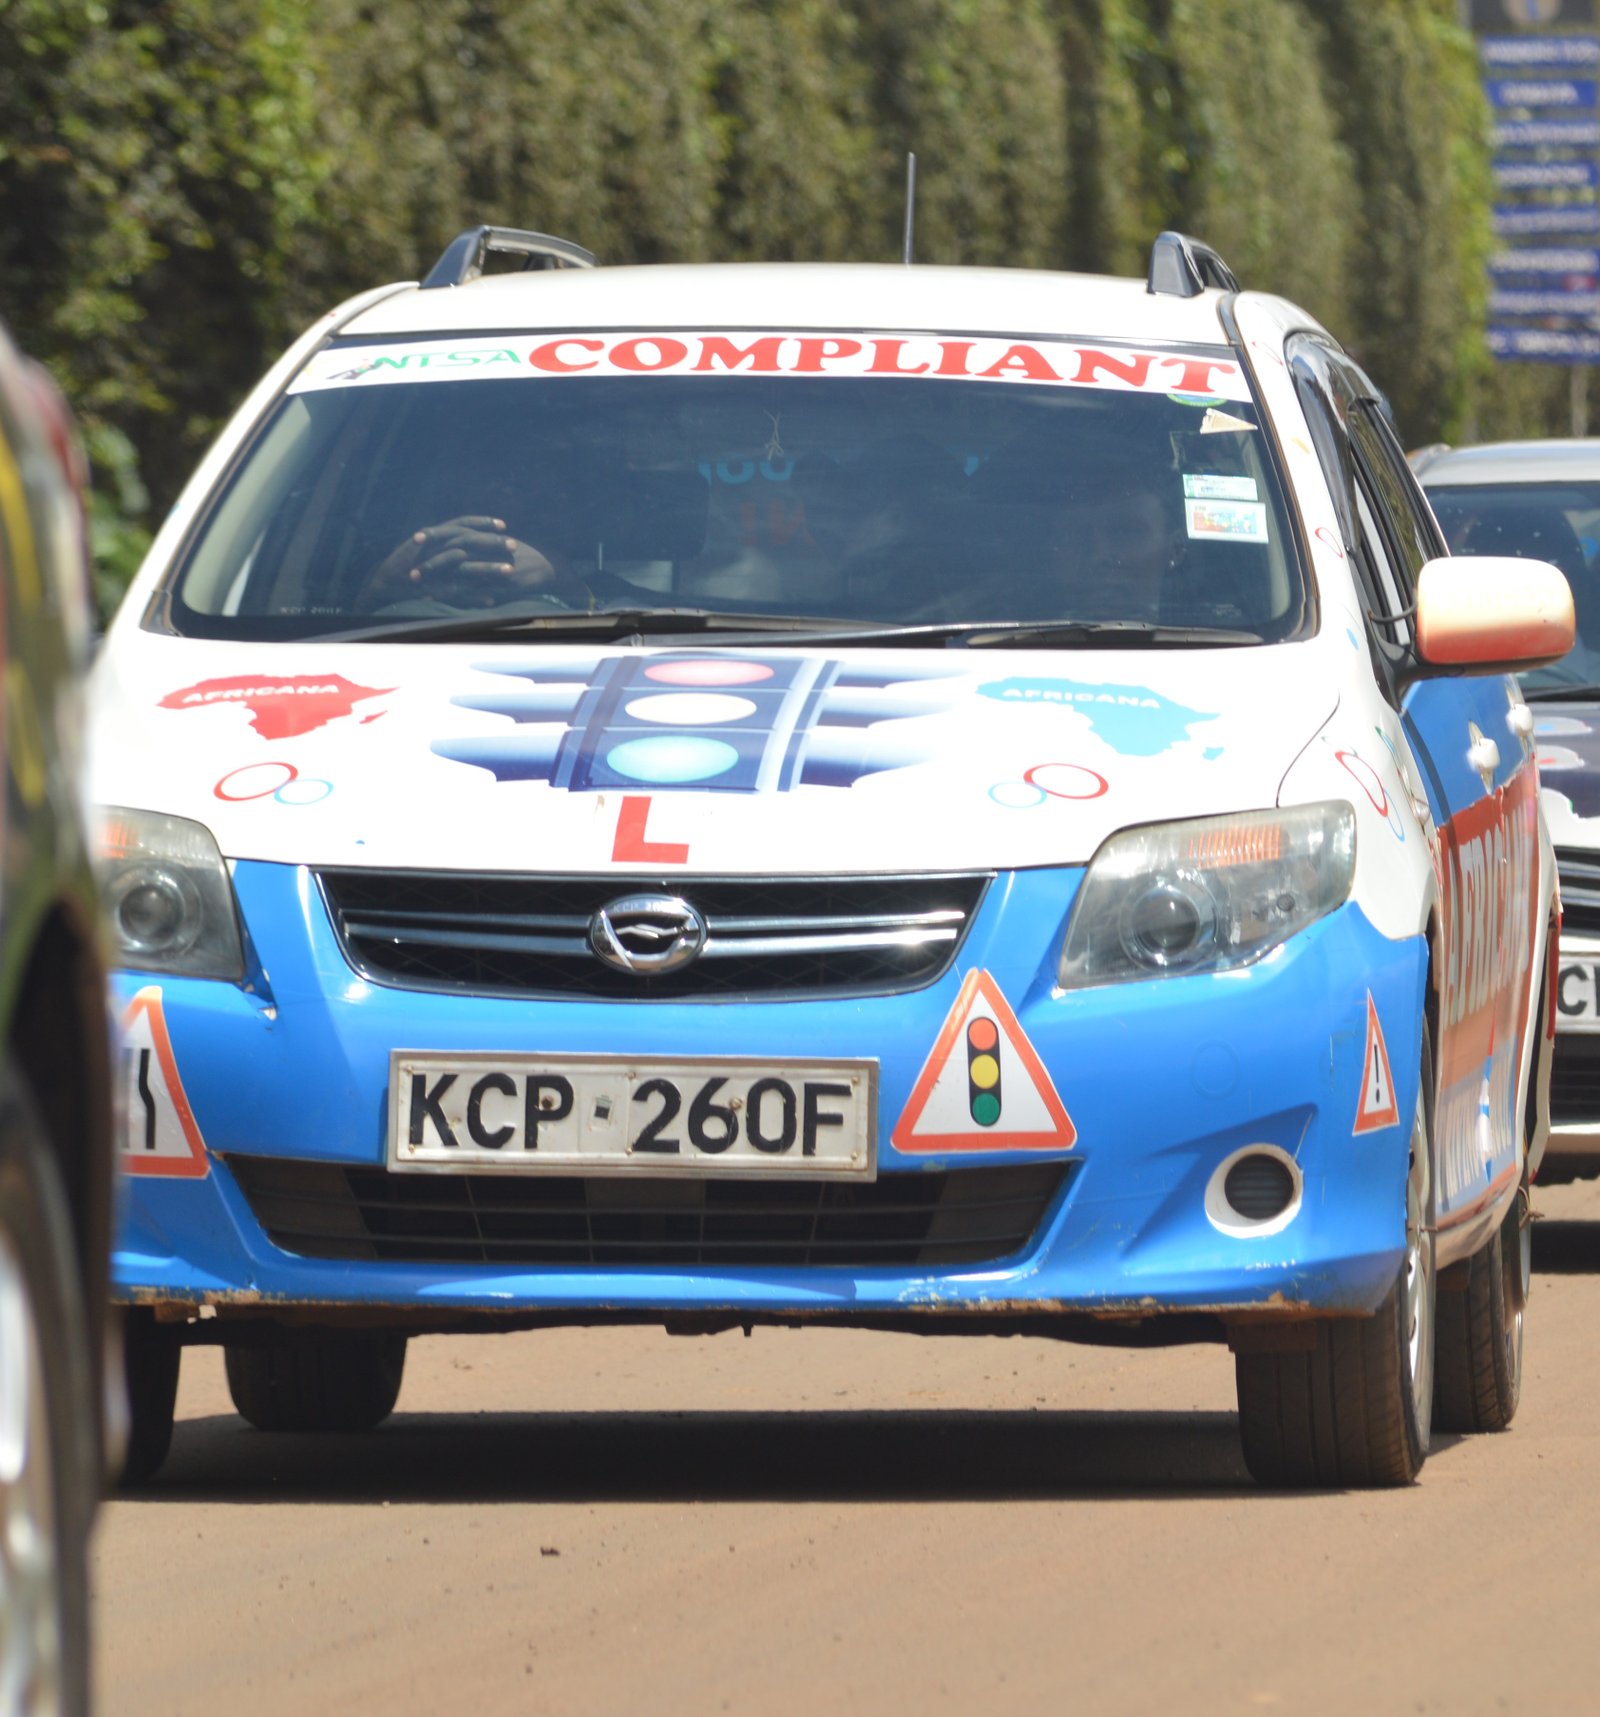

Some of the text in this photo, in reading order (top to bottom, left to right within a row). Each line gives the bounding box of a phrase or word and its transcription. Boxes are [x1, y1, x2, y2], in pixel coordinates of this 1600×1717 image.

[373, 336, 1236, 393] NTSA COMPLIANT
[182, 684, 340, 704] AFRICANA
[1002, 688, 1161, 709] AFRICANA
[611, 795, 690, 865] L
[410, 1072, 853, 1157] KCP 260F
